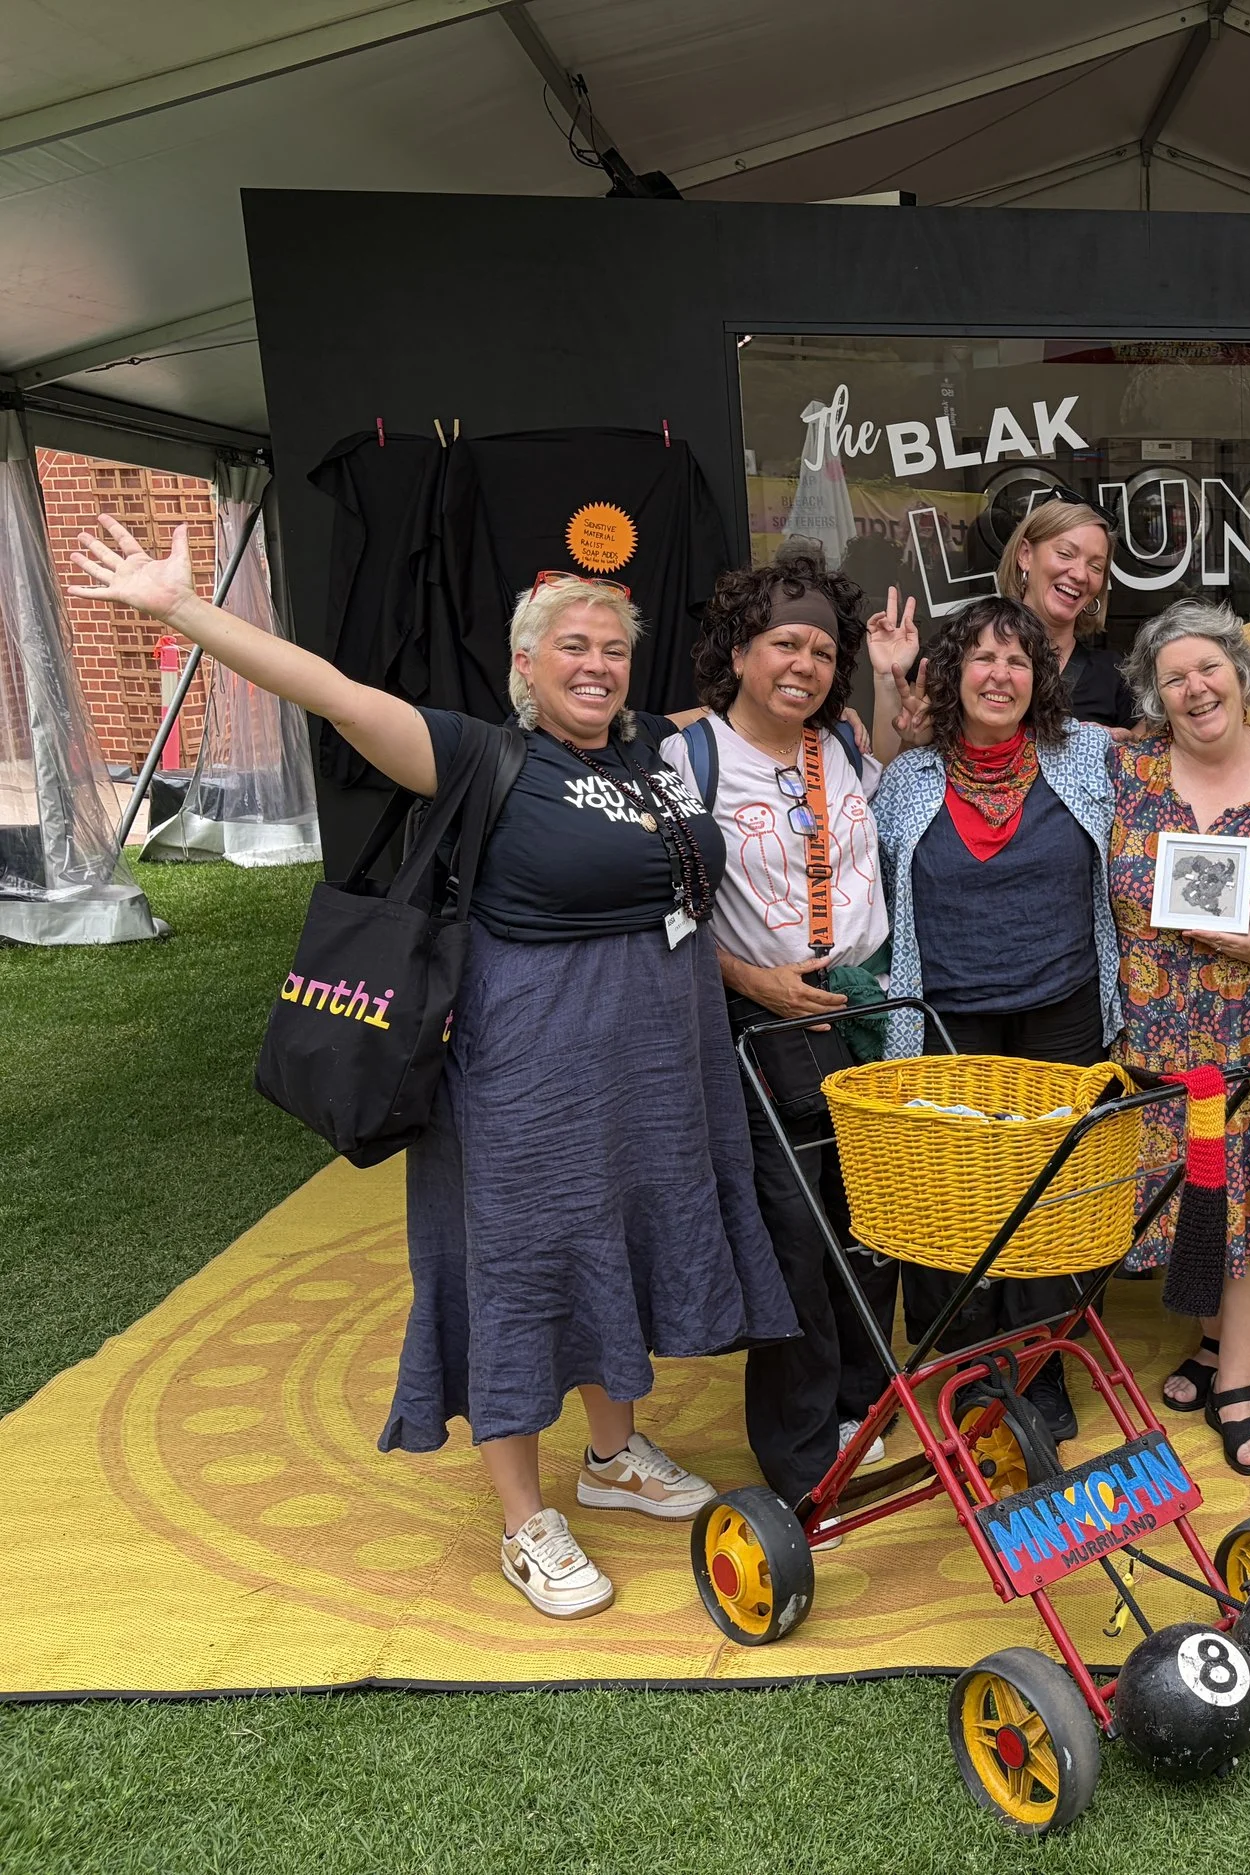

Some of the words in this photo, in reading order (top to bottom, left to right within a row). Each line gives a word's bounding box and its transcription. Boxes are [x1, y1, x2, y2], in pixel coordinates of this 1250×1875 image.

[801, 384, 882, 472] The
[885, 395, 1090, 478] BLAK
[580, 538, 604, 549] RACIST
[583, 529, 616, 542] MATERIAL
[581, 547, 600, 558] SOAP
[564, 776, 618, 795] WH
[563, 791, 625, 808] YOU
[1060, 1512, 1158, 1570] MURRILAND
[1197, 1638, 1238, 1694] 8
